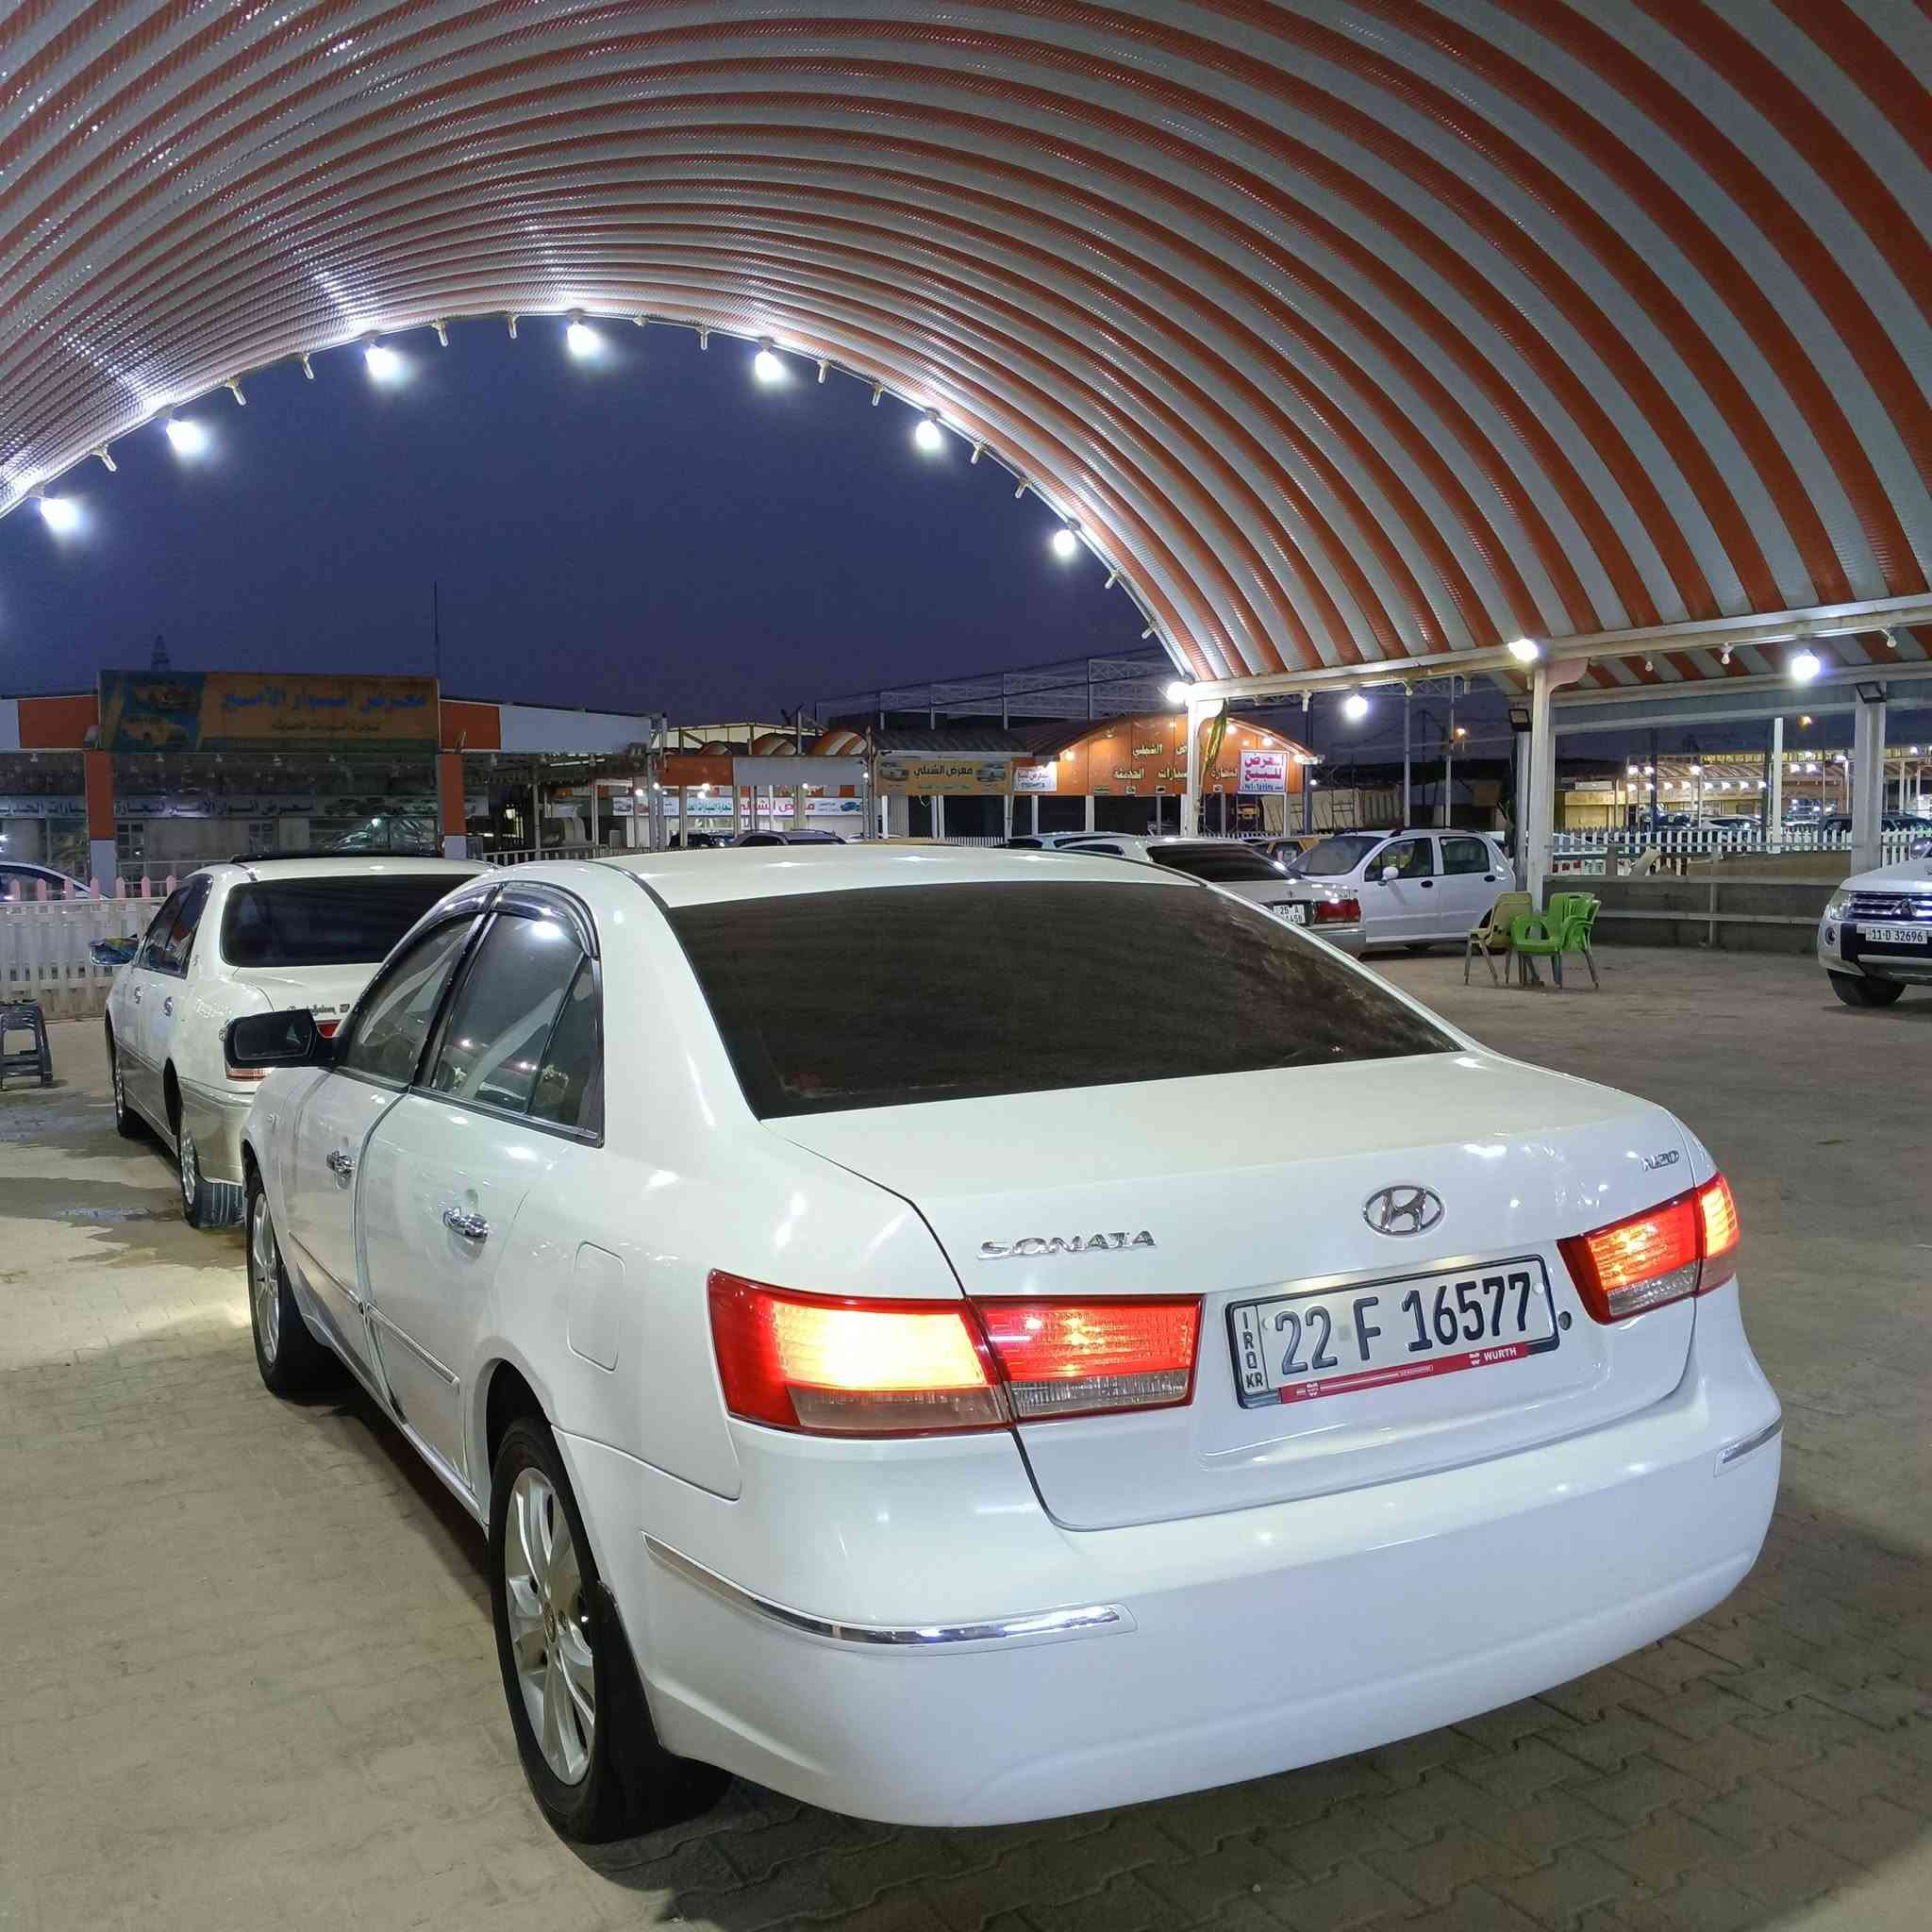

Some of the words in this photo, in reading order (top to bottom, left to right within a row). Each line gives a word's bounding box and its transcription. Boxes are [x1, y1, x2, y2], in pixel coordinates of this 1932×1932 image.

[1894, 929, 1924, 942] 32696
[975, 1229, 1157, 1260] SONATA
[1274, 1305, 1339, 1375] 22
[1352, 1295, 1381, 1361] F
[1401, 1271, 1531, 1353] 16577
